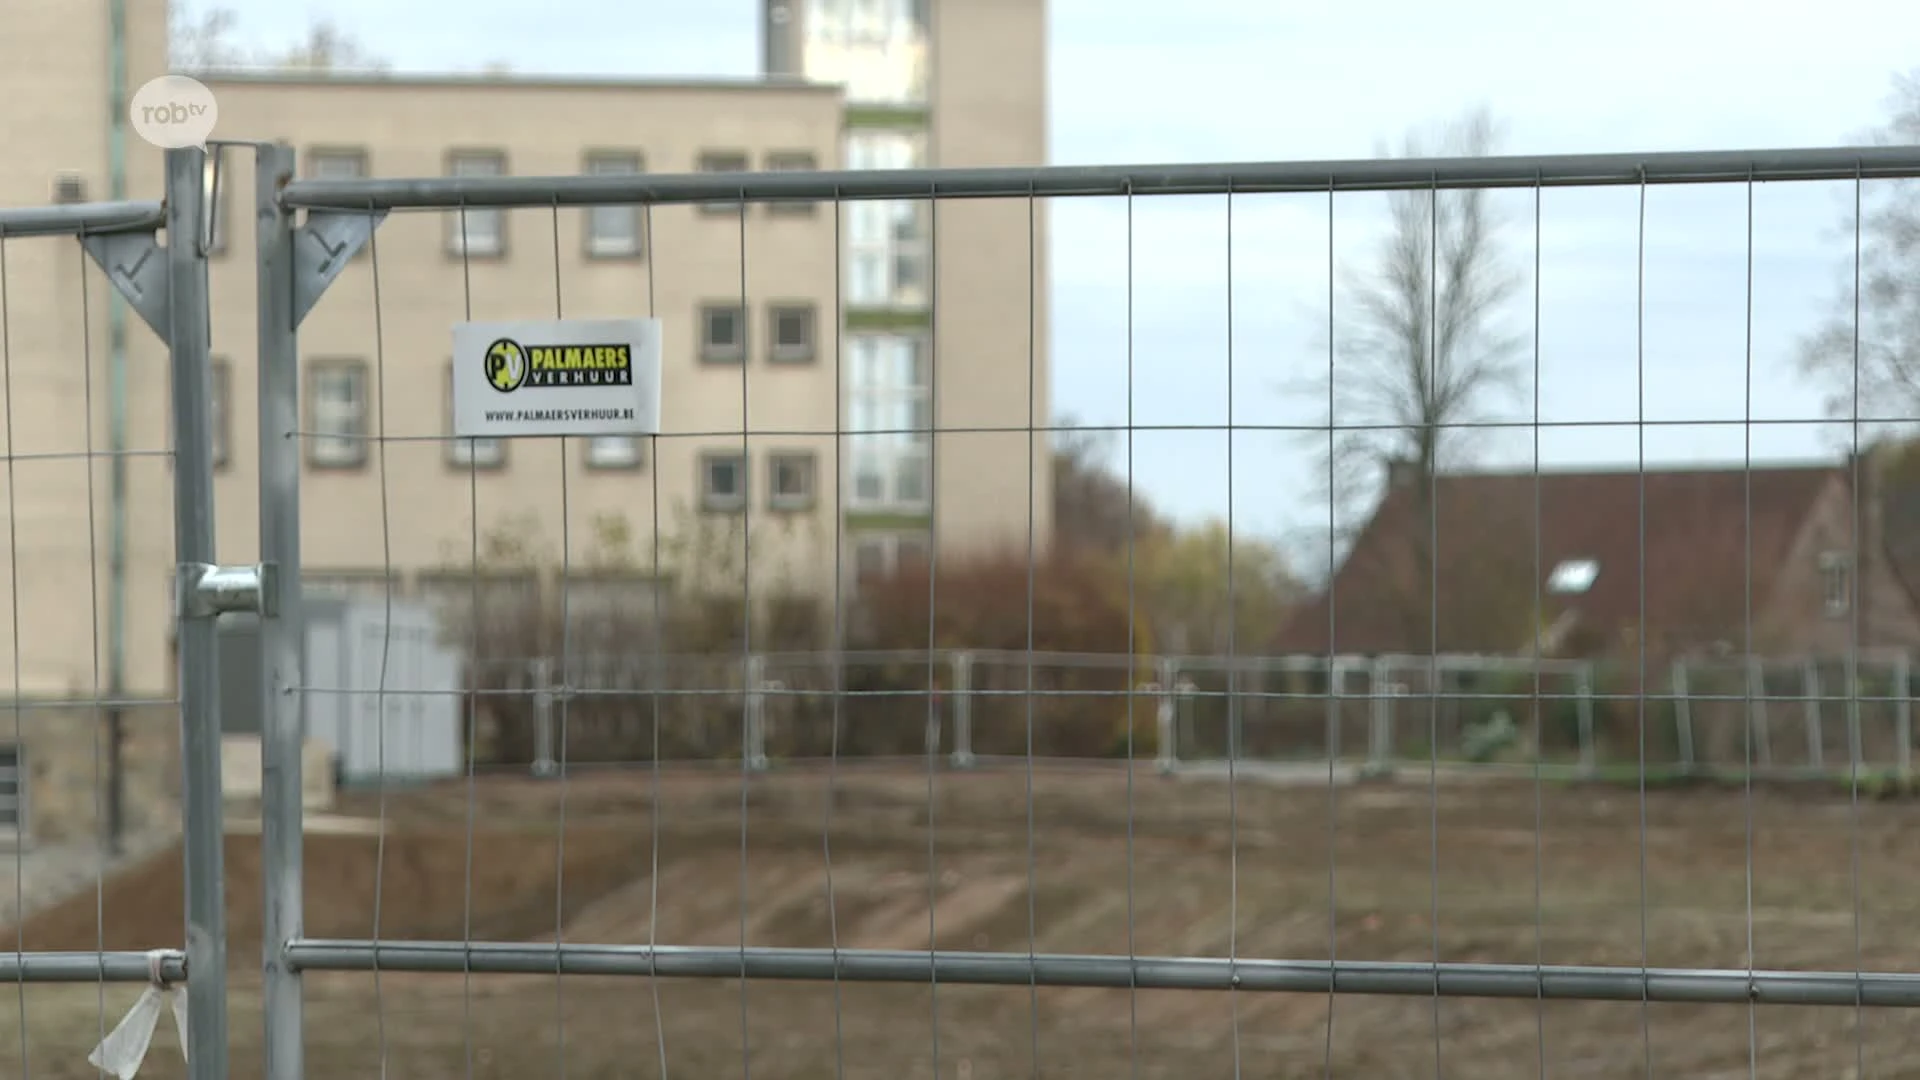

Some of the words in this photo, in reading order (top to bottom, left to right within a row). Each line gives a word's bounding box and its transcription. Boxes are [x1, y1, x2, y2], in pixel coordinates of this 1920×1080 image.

[531, 347, 628, 369] PALMAERS
[532, 371, 629, 384] VERHUUR
[485, 408, 634, 421] WWW.PALMAERSVERHUUR.BE
